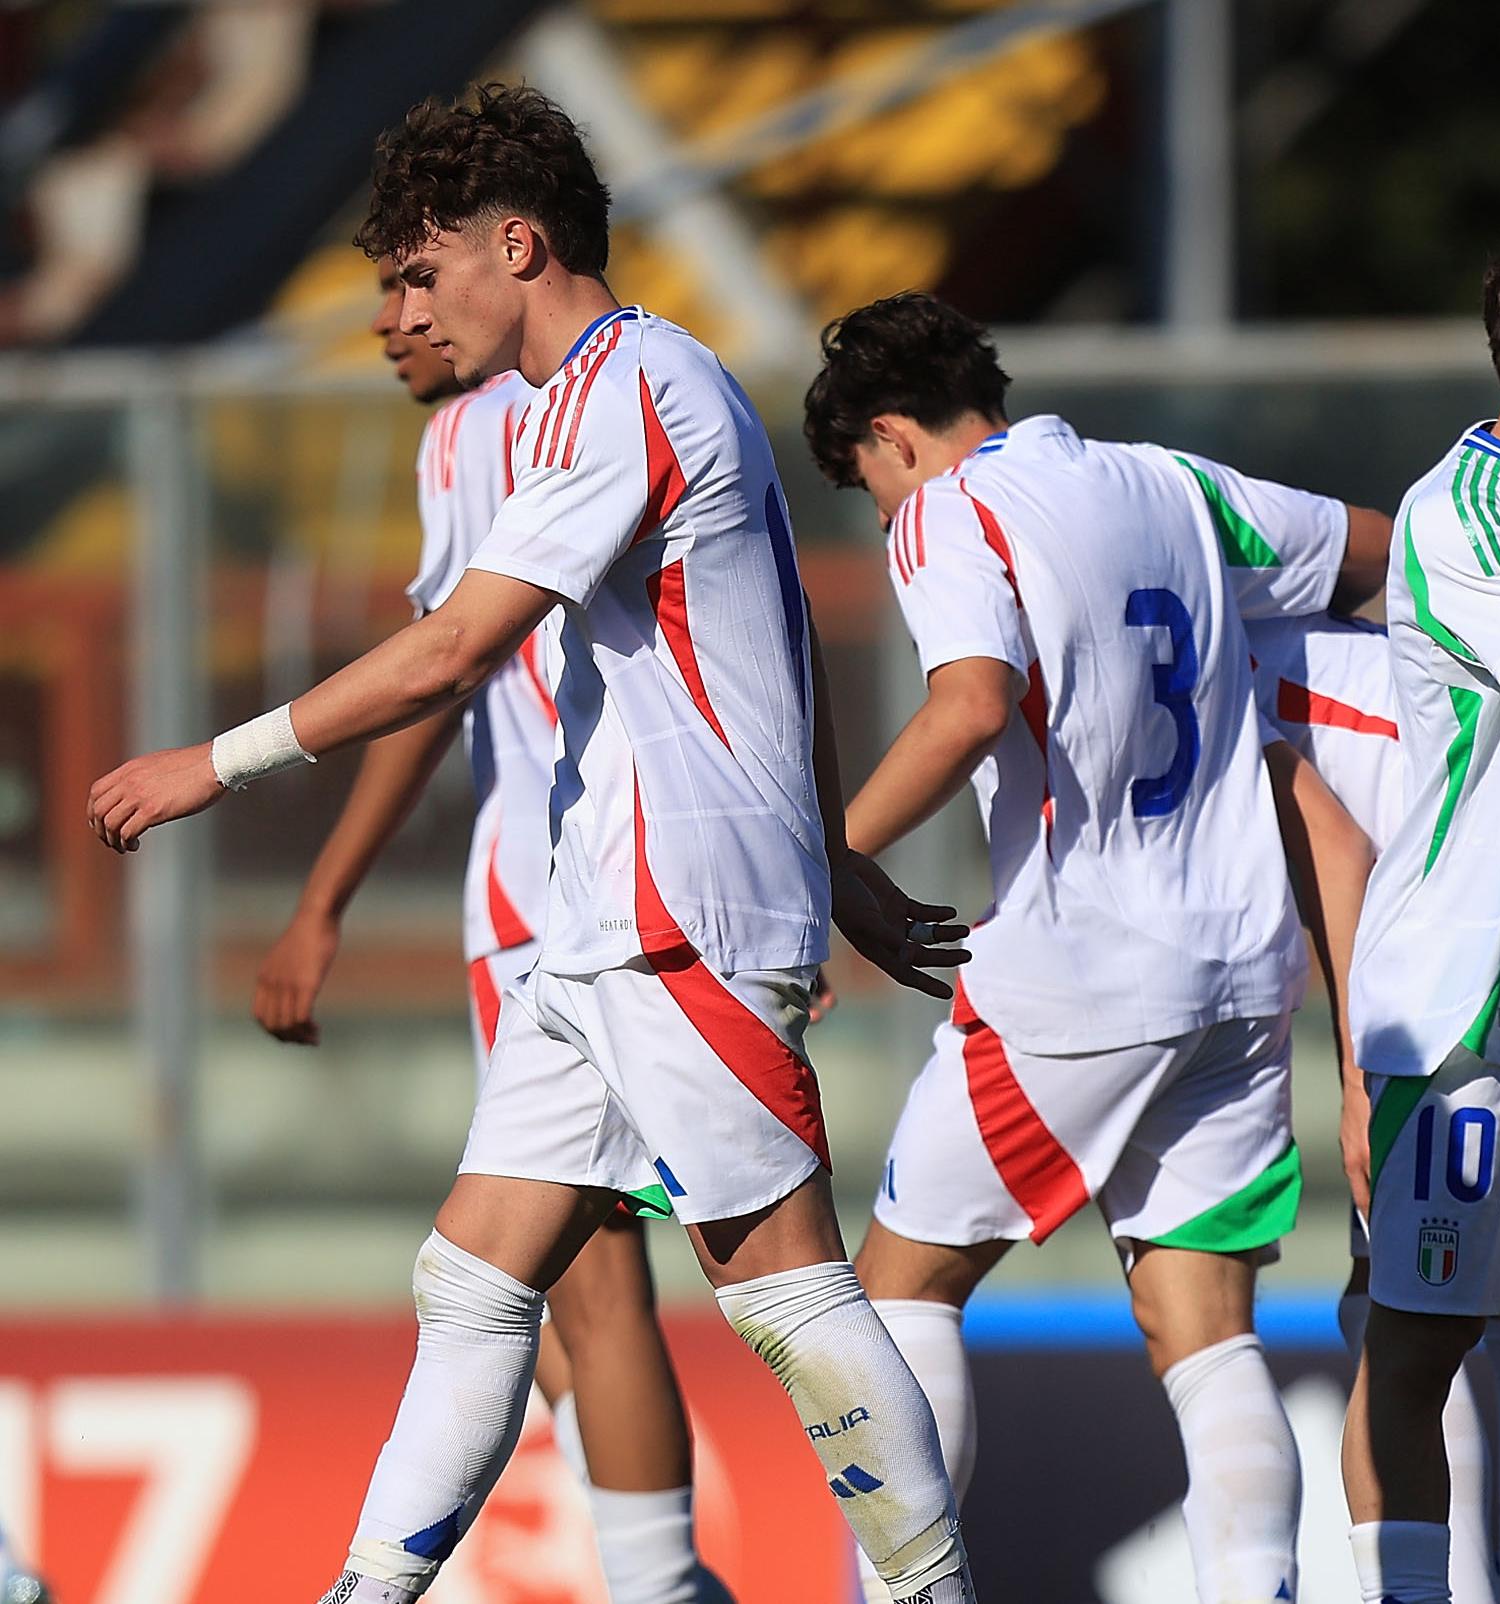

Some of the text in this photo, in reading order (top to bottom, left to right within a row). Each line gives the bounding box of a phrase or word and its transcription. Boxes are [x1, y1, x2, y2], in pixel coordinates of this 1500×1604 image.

[1125, 588, 1201, 818] 3
[1414, 1104, 1497, 1204] 10
[1423, 1231, 1455, 1245] ITALIA
